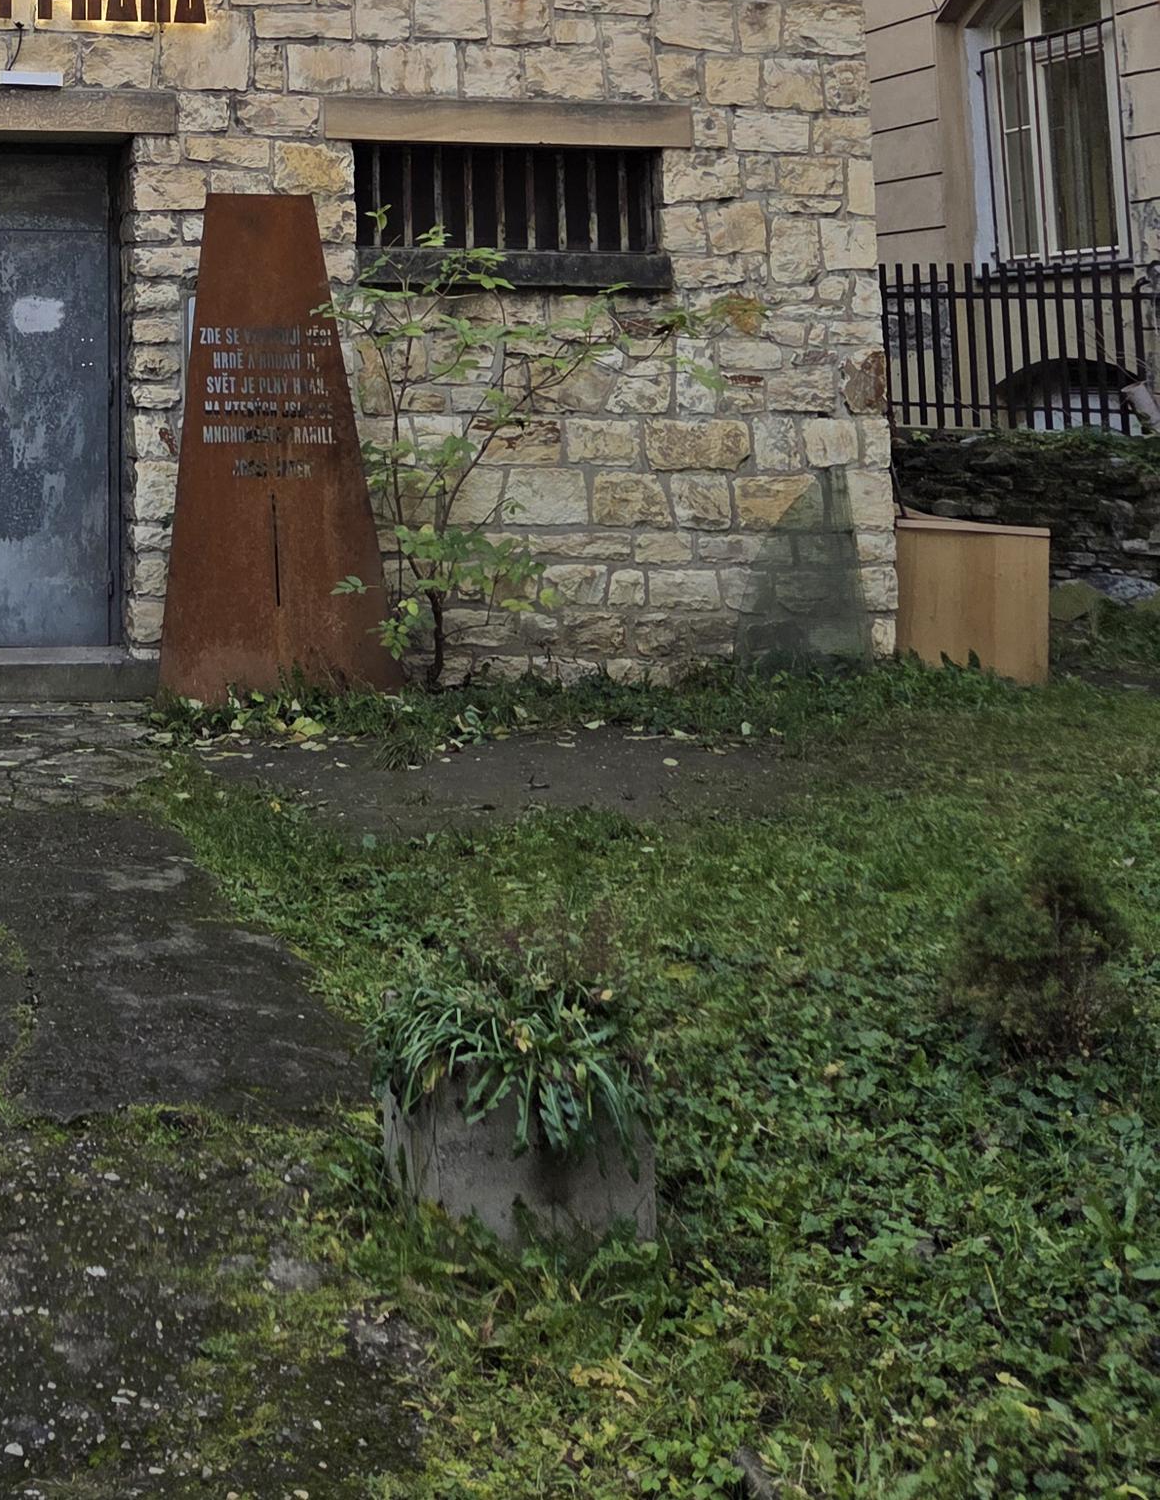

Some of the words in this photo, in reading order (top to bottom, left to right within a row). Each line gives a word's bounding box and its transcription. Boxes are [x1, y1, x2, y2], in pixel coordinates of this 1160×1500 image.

[199, 327, 222, 345] ZDE
[225, 327, 240, 345] SE
[206, 372, 236, 394] SVĚT
[241, 376, 254, 394] JE
[259, 374, 288, 394] PLNÝ
[204, 401, 221, 418] NA
